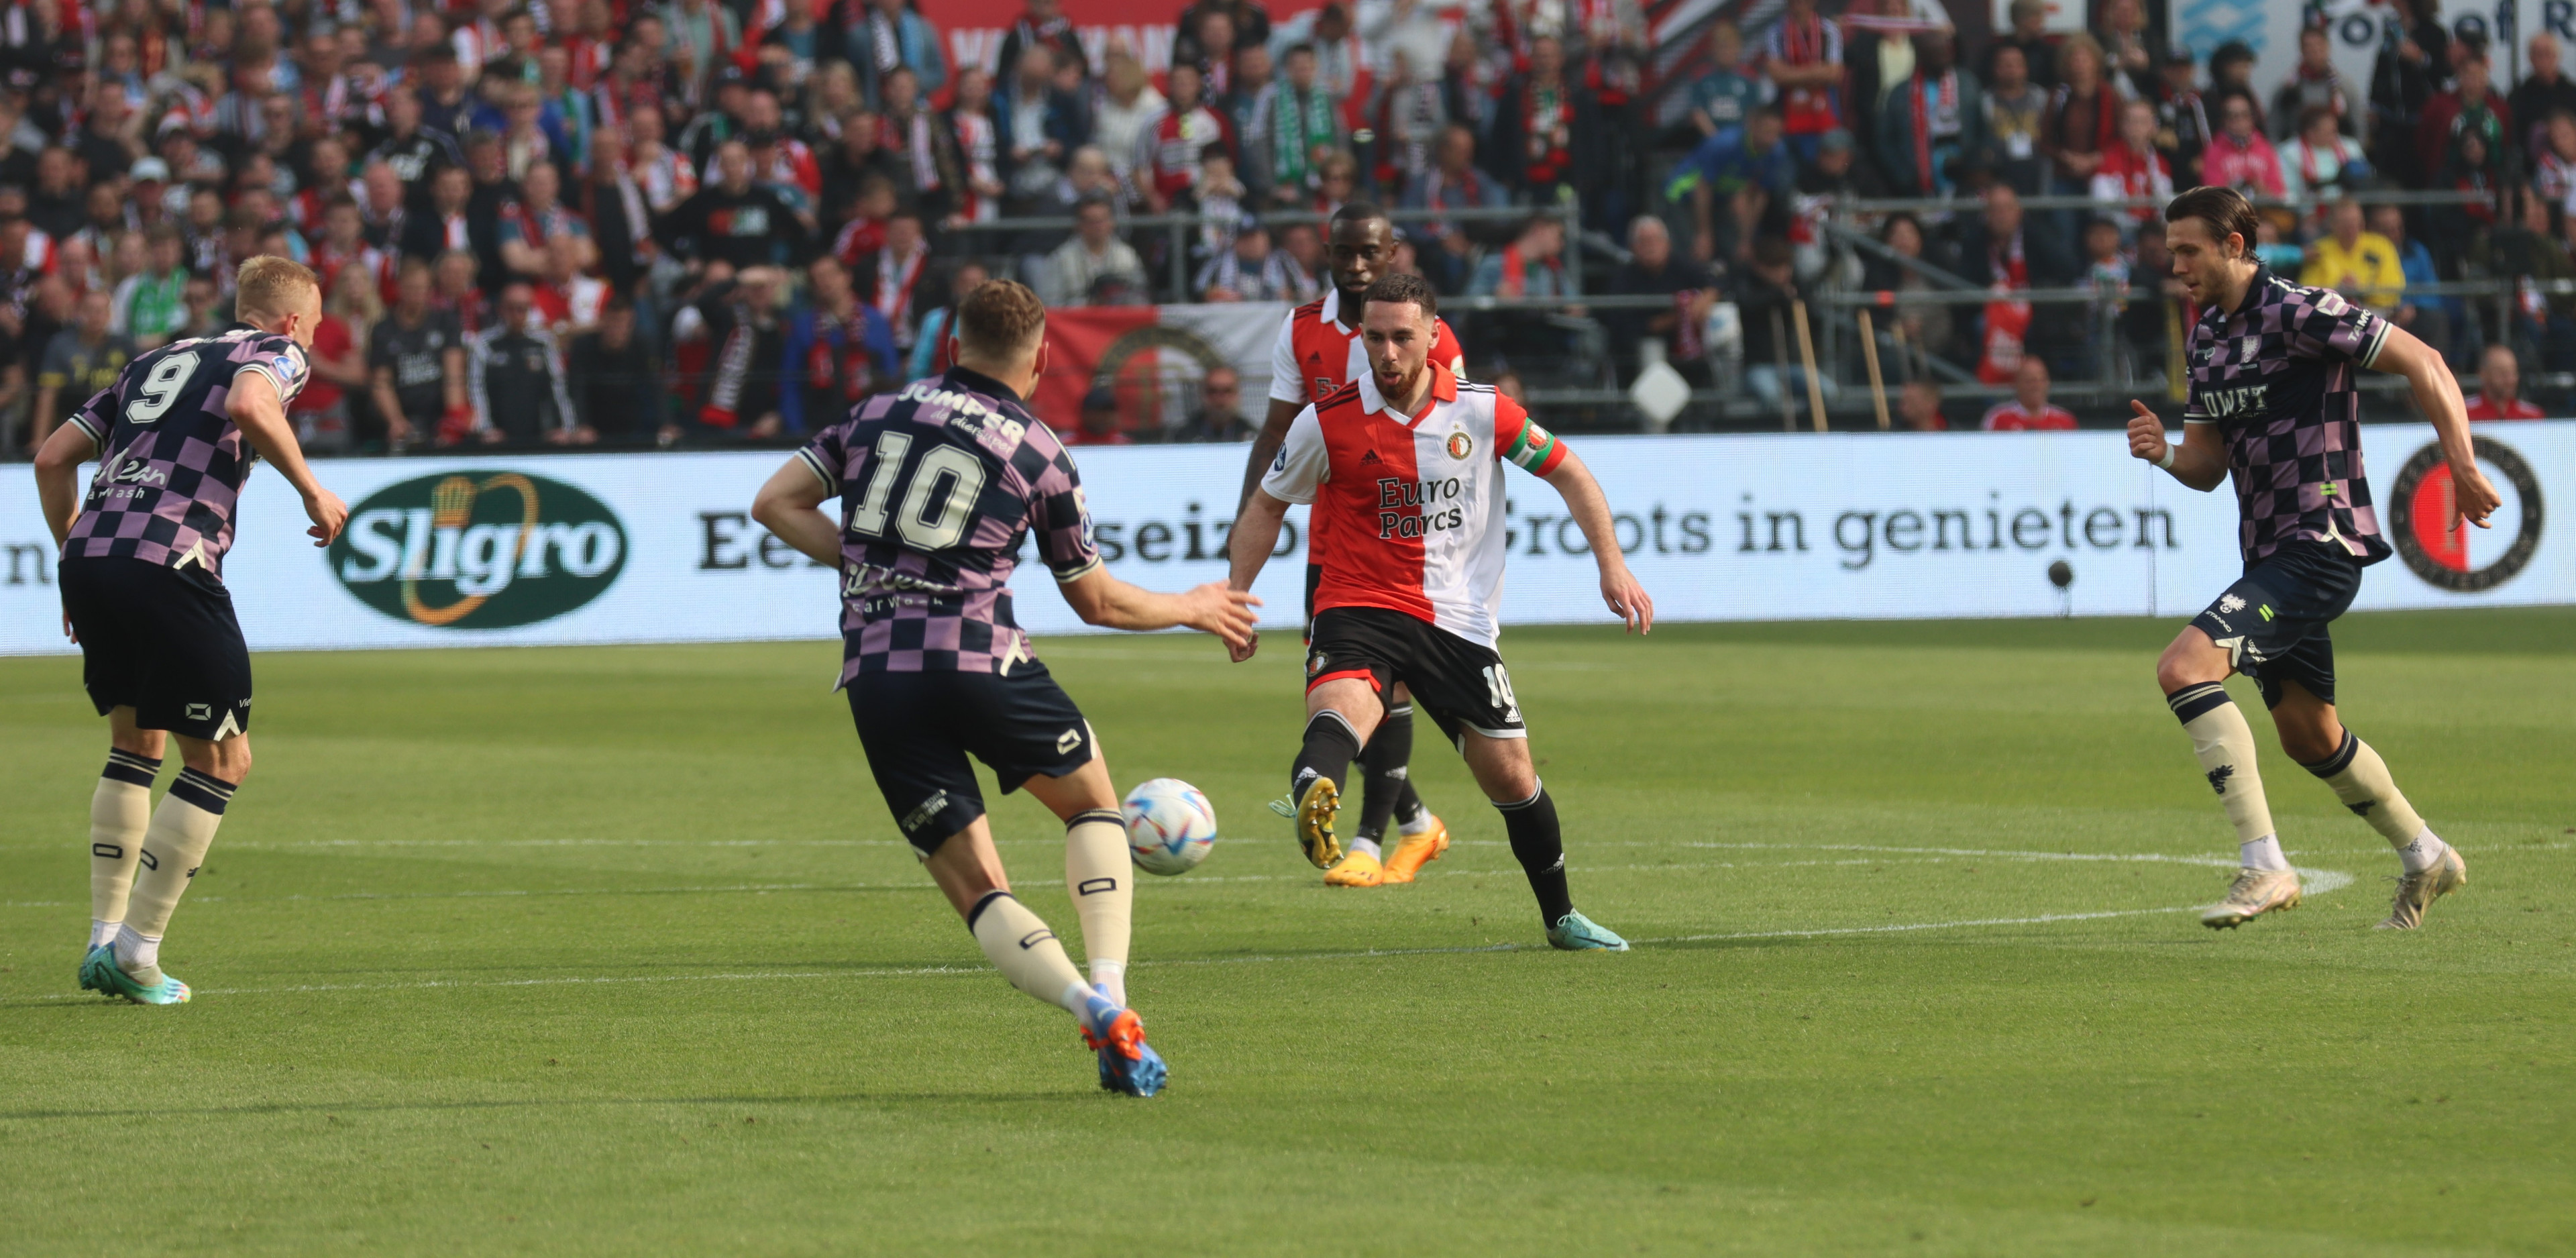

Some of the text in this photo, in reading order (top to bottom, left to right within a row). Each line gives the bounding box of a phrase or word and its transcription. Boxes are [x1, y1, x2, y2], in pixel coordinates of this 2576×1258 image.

[125, 351, 201, 424] 9
[2200, 383, 2269, 418] OWET
[897, 382, 1026, 445] JUMPER
[950, 416, 1015, 456] diersuper
[851, 431, 986, 551] 10
[1377, 476, 1460, 509] Euro
[697, 511, 826, 571] Ee
[1737, 493, 1810, 552] in
[1834, 489, 2180, 570] genieten
[1379, 507, 1463, 539] Parcs
[341, 508, 623, 597] Sligro
[2205, 610, 2233, 633] STANNO
[1482, 664, 1517, 709] 10
